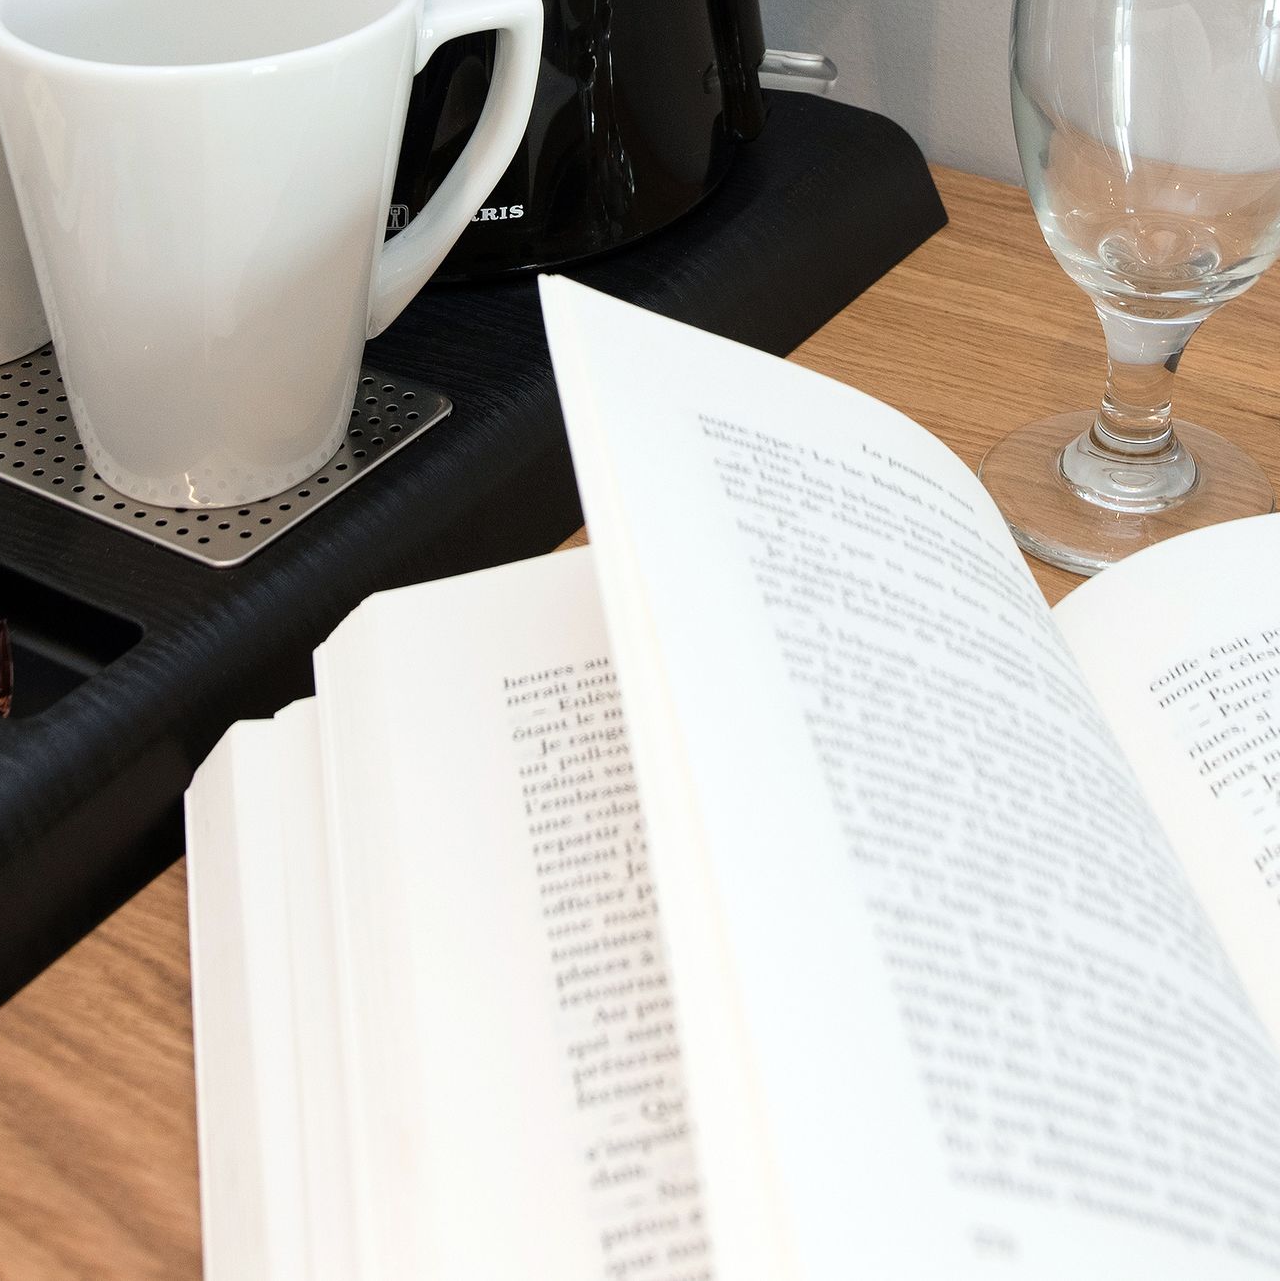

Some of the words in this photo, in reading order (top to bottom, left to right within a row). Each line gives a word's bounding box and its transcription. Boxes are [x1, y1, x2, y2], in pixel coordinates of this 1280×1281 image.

[1150, 660, 1199, 693] coiffe
[1209, 637, 1250, 660] était
[1159, 669, 1221, 709] monde
